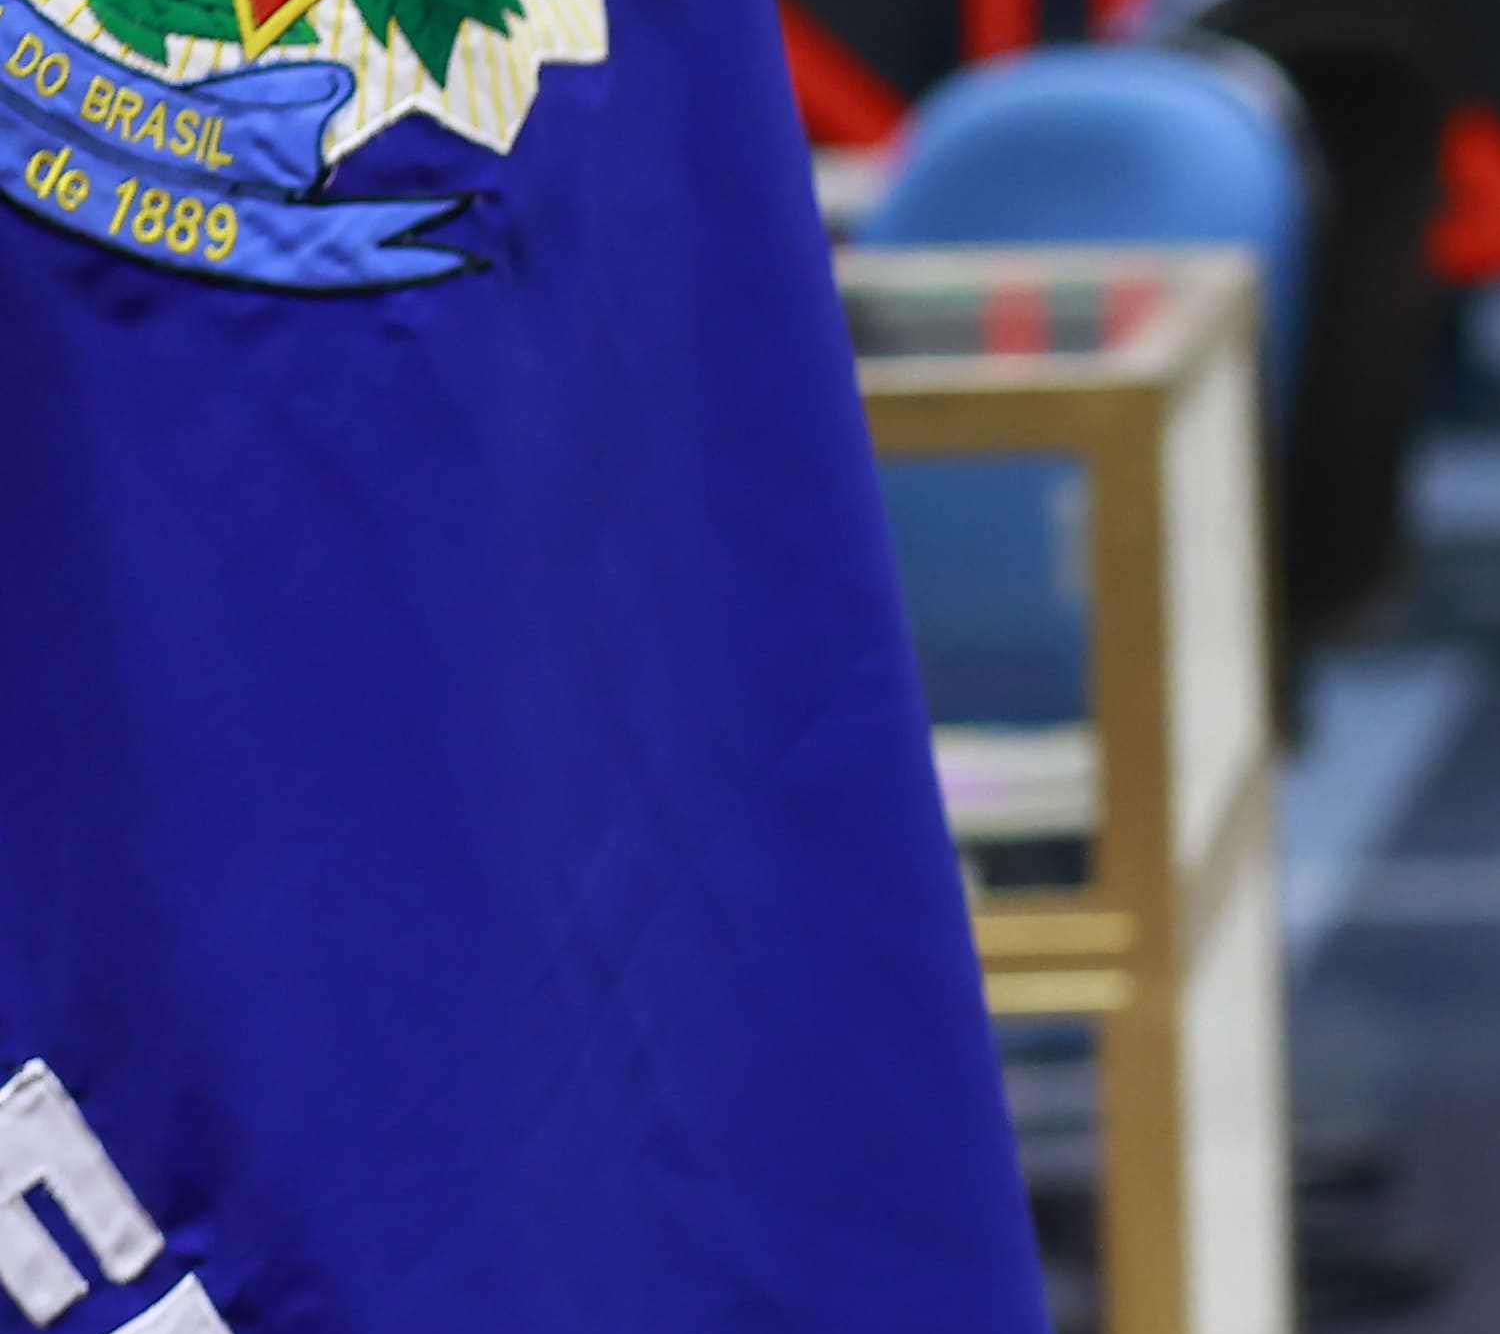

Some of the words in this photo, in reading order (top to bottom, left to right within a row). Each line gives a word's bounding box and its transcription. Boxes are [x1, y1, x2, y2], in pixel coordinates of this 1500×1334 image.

[5, 33, 70, 98] DO
[80, 74, 233, 170] BRASIL
[24, 146, 89, 212] de
[108, 177, 239, 262] 1889
